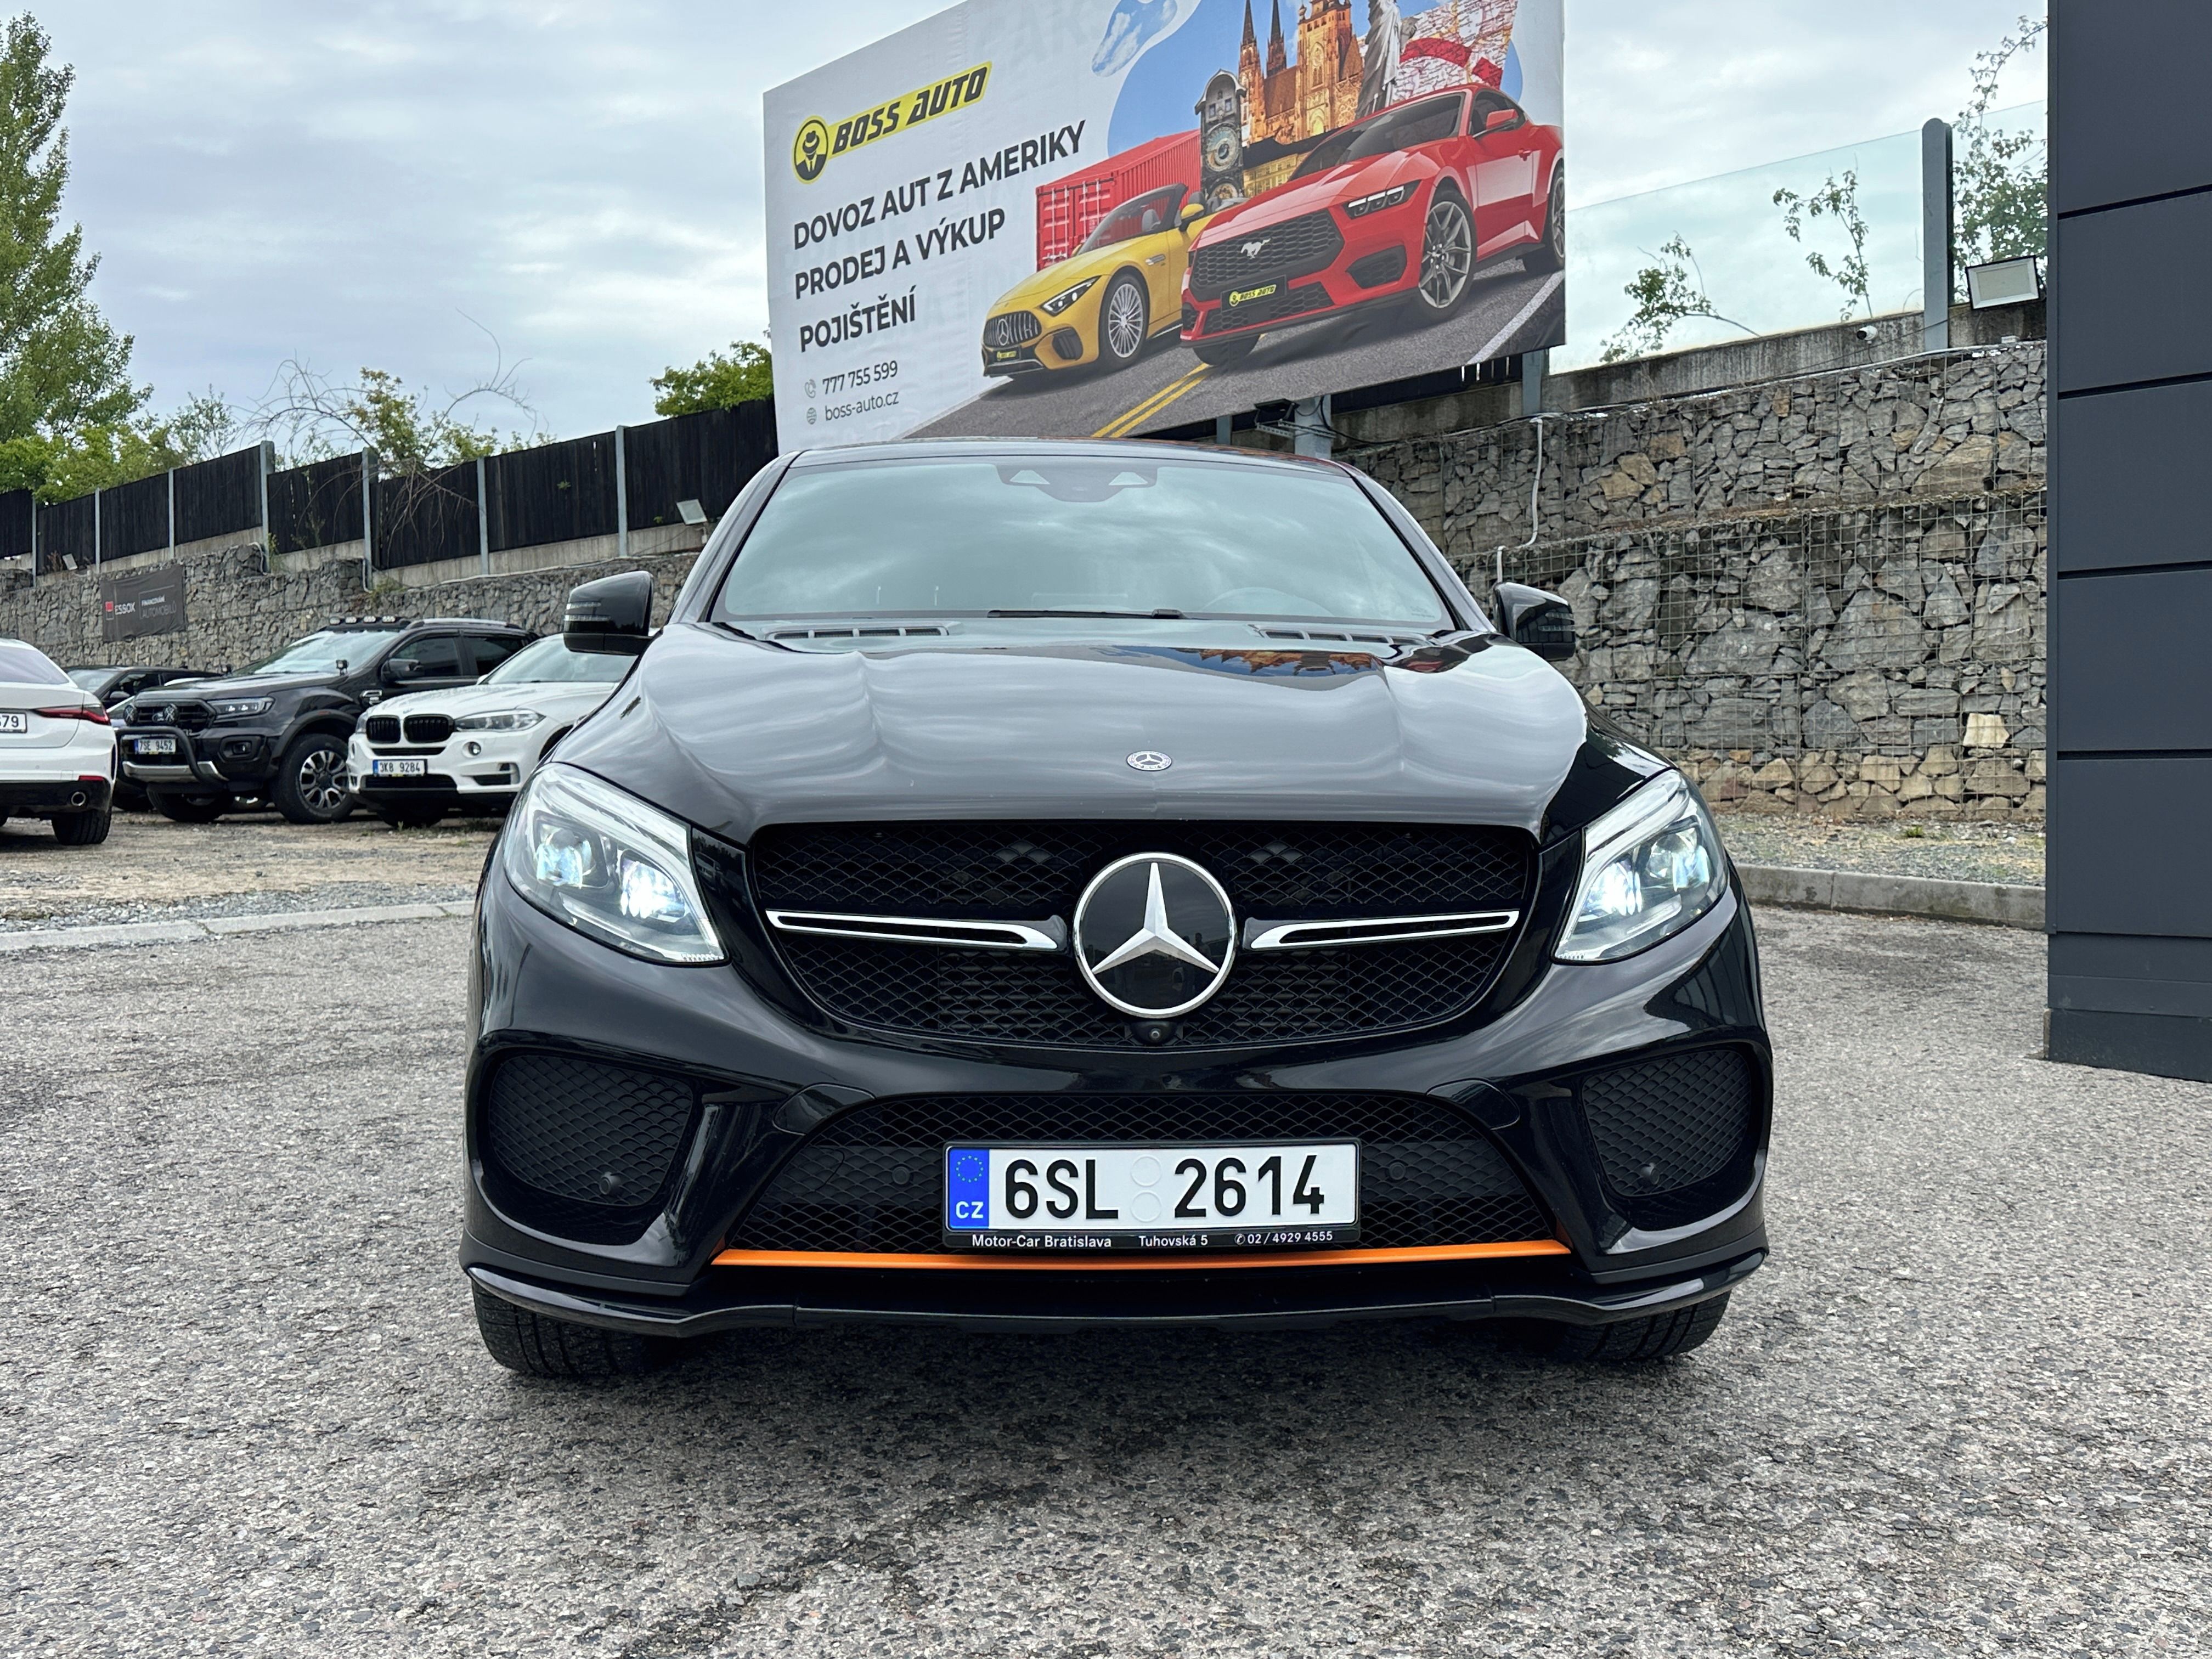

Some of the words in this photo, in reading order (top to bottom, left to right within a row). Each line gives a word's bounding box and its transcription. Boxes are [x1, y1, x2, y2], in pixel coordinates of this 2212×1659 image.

[832, 101, 901, 155] BOSS
[906, 67, 987, 126] AUTO
[794, 197, 876, 250] DOVOZ
[881, 177, 930, 221] AUT
[937, 170, 953, 201] Z
[960, 120, 1086, 195] AMERIKY
[795, 247, 885, 300] PRODEJ
[892, 239, 910, 269] A
[916, 208, 1005, 261] VÝKUP
[800, 285, 917, 352] POJIŠTĚNÍ
[822, 374, 845, 394] 777
[848, 367, 871, 388] 755
[874, 360, 898, 381] 599
[825, 392, 899, 421] boss-auto.cz
[114, 602, 136, 615] ESSOX
[0, 715, 19, 727] 79
[1005, 1159, 1118, 1219] 6SL
[1175, 1155, 1324, 1218] 2614
[956, 1201, 984, 1219] CZ
[972, 1234, 1040, 1247] Motor-Car
[1045, 1234, 1111, 1247] Bratislava
[1138, 1234, 1196, 1246] Tuhovská
[1200, 1235, 1208, 1245] 5
[1305, 1231, 1333, 1242] 4555
